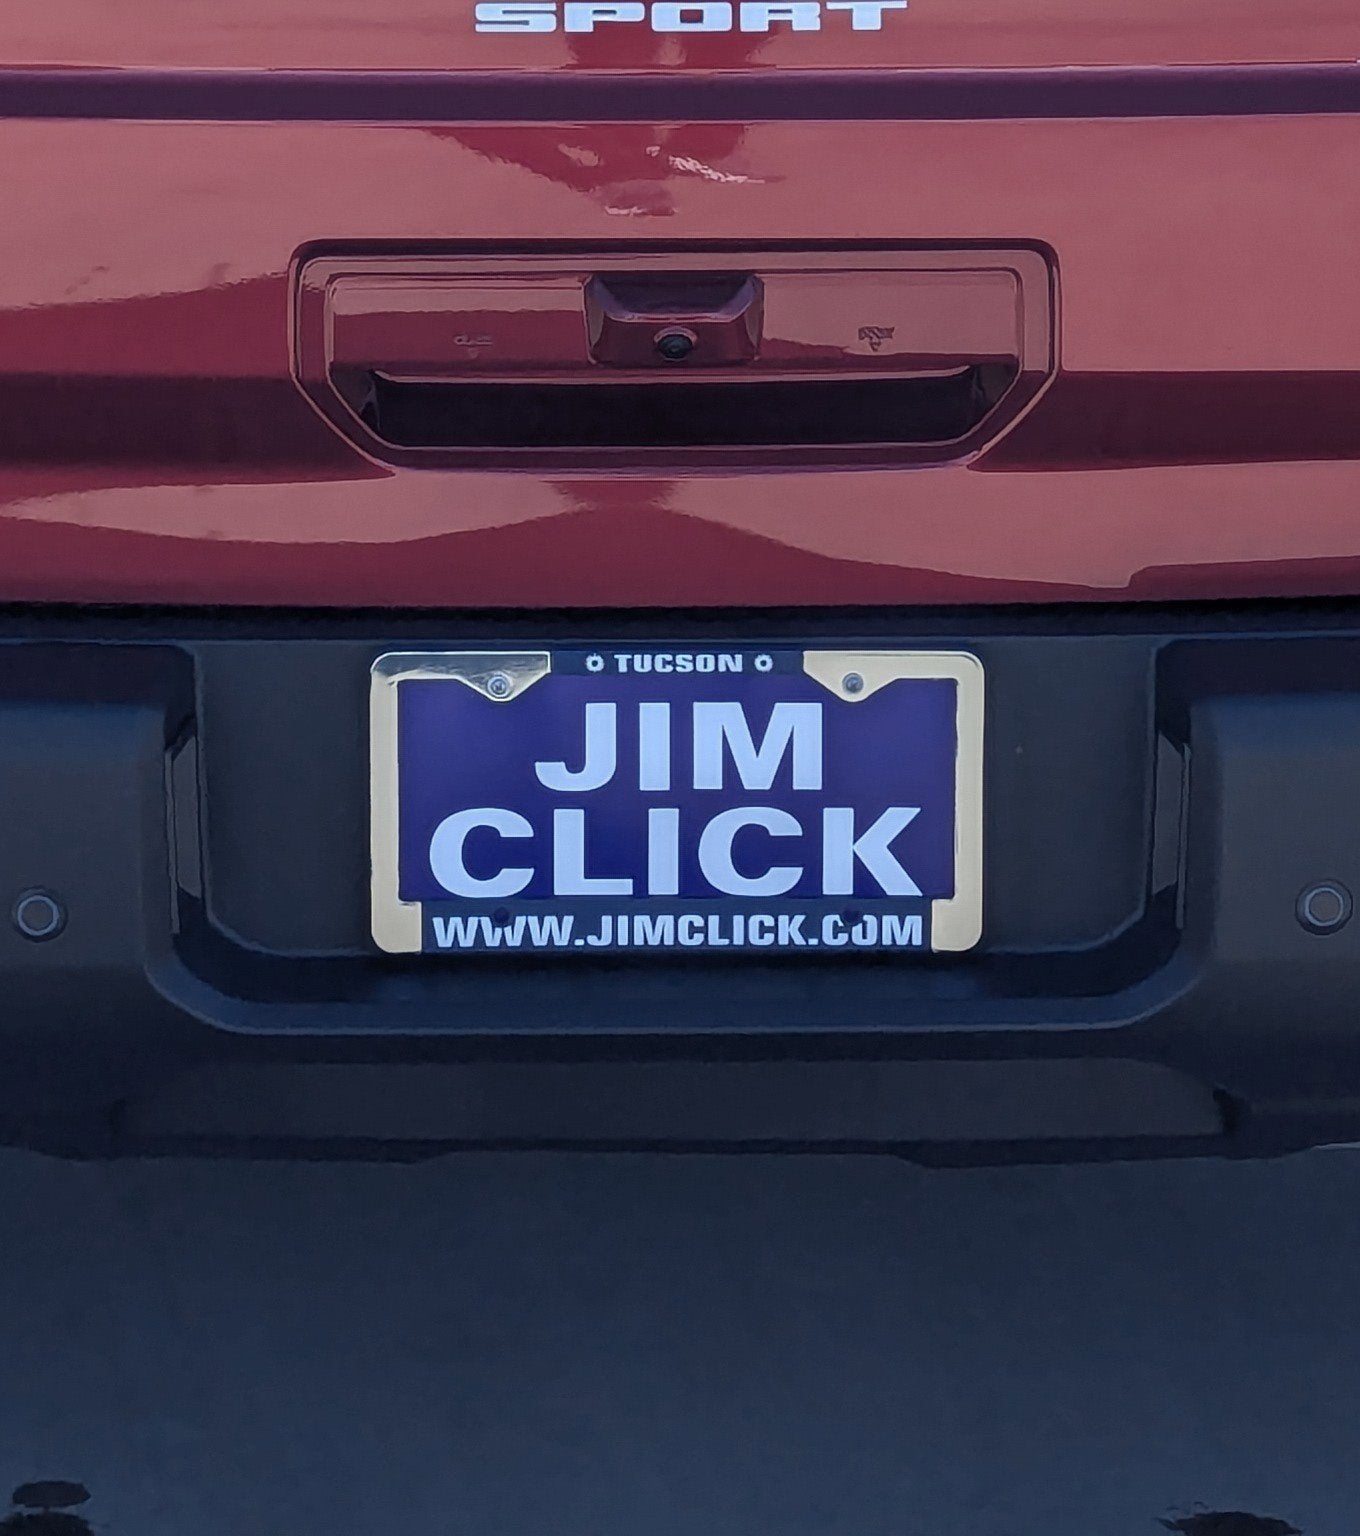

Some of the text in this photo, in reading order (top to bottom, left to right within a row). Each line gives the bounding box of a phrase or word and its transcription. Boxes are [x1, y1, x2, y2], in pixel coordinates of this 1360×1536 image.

[474, 0, 908, 33] SPORT
[614, 653, 743, 673] TUCSON
[535, 702, 823, 792] JIM
[429, 807, 923, 898] CLICK
[433, 914, 923, 948] WWW.JIMCLICK.COM
